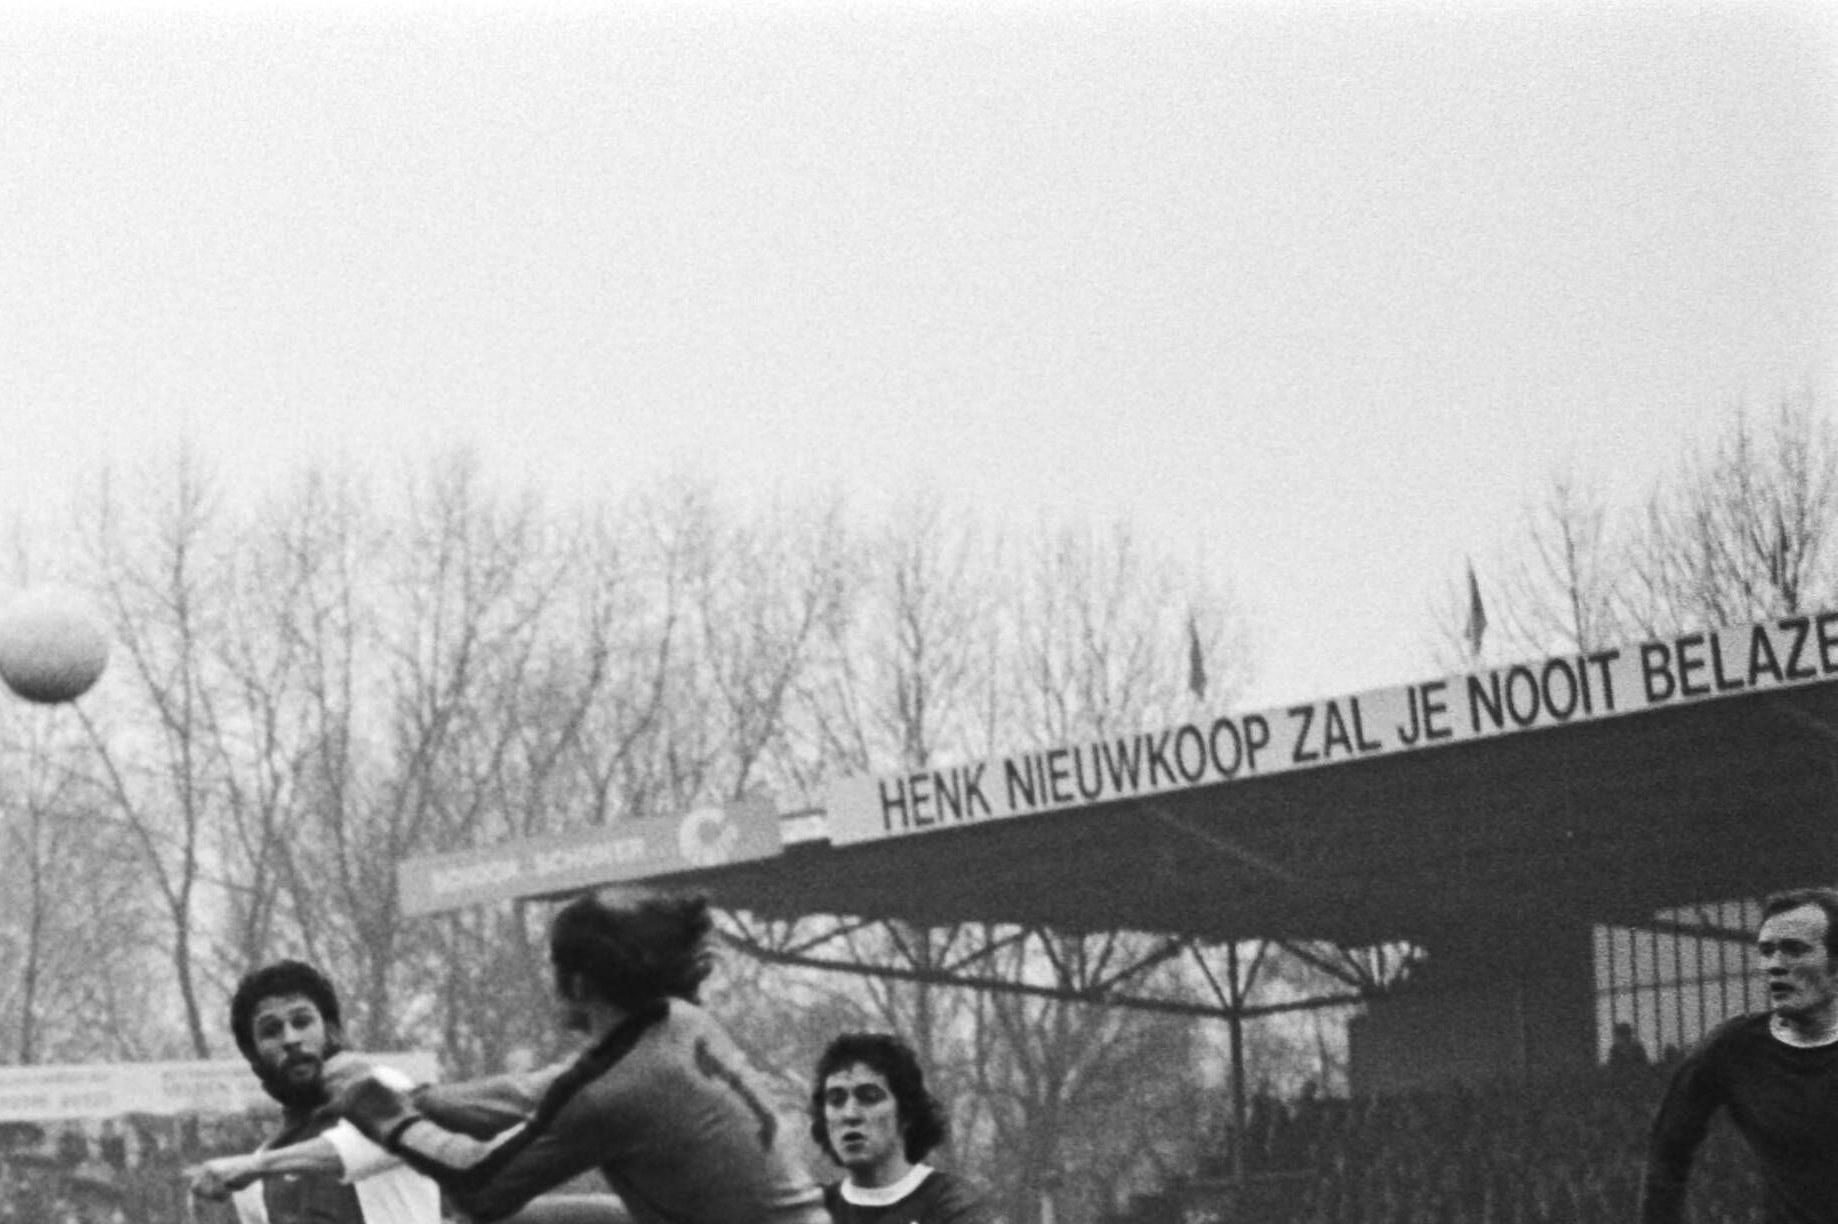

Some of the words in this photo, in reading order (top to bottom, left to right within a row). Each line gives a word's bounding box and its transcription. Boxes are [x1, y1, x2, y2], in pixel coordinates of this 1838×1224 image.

[878, 764, 988, 832] HENK
[1004, 713, 1271, 812] NIEUWKOOP
[1287, 694, 1381, 765] ZAL
[1397, 681, 1454, 747] JE
[1467, 648, 1622, 734] NOOIT
